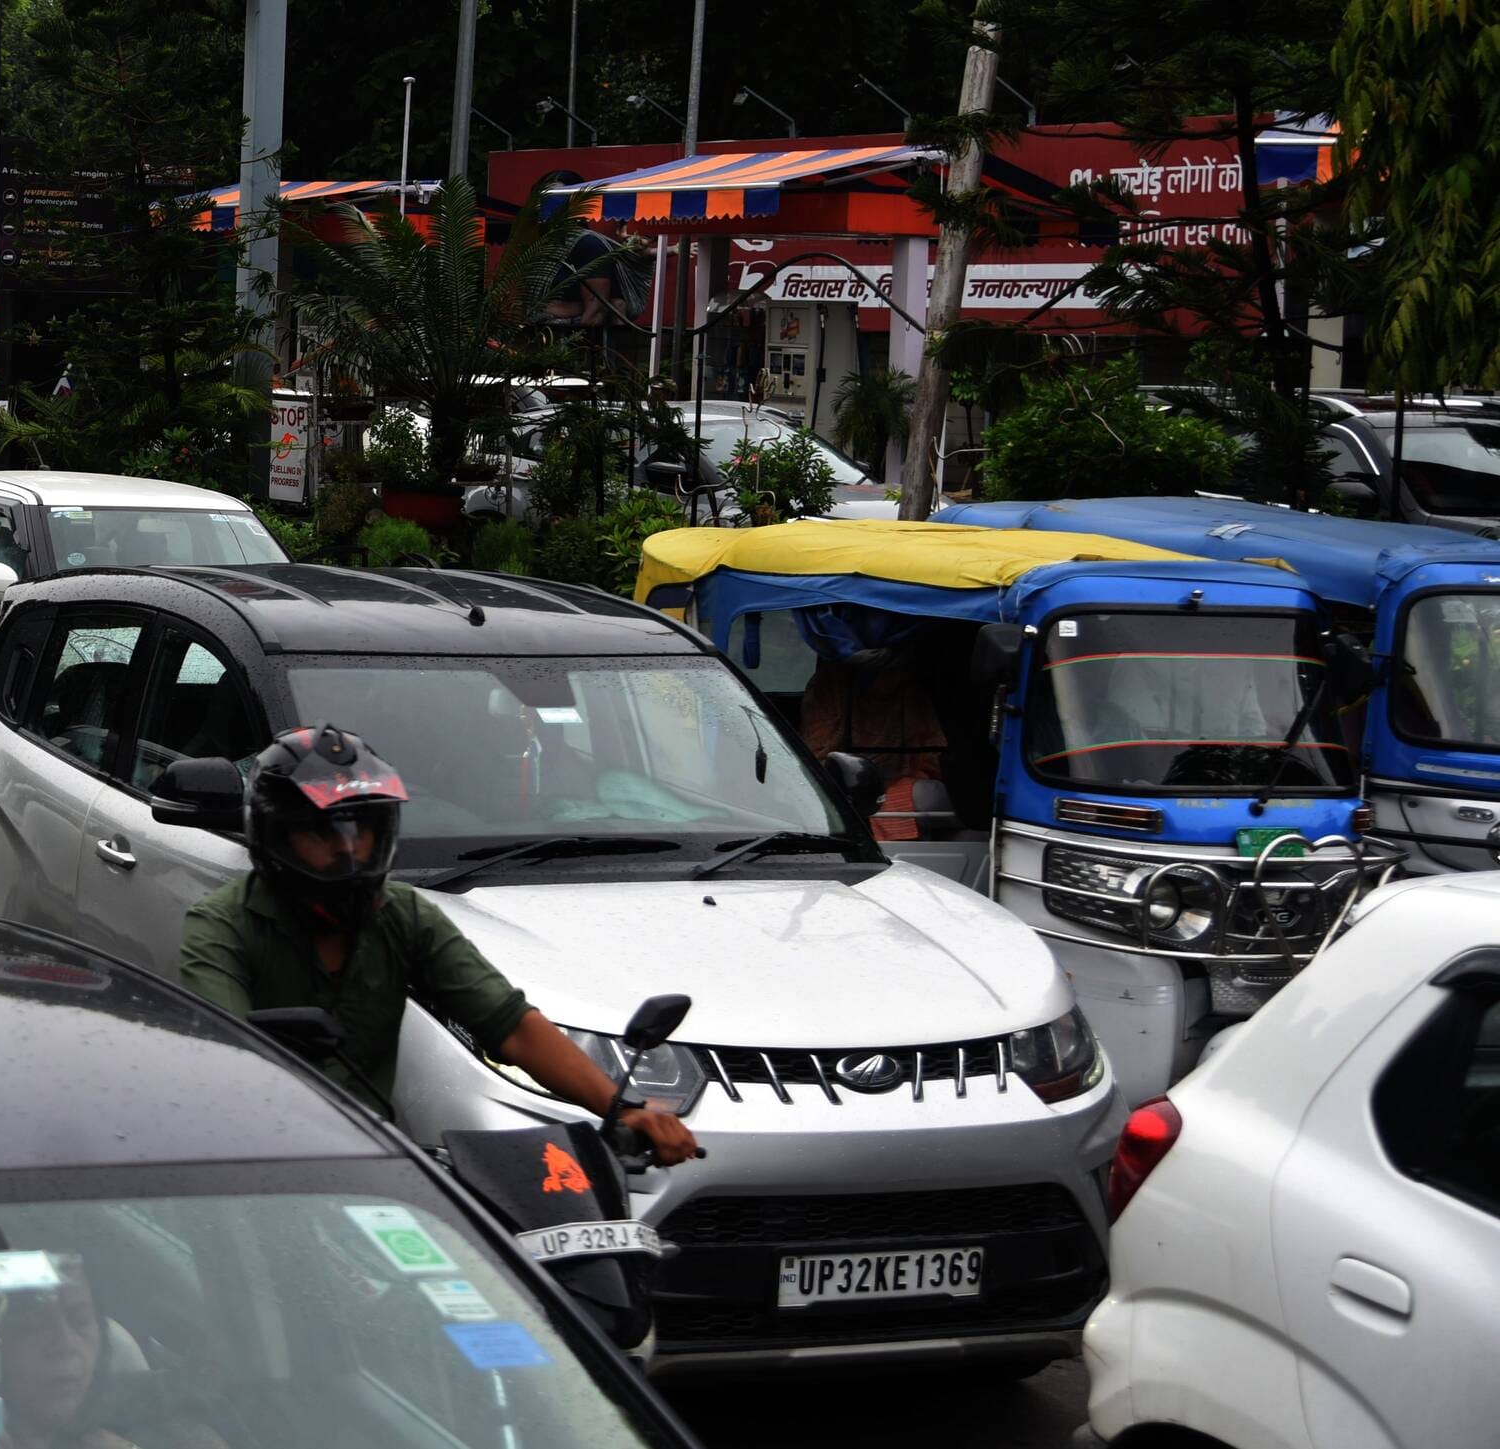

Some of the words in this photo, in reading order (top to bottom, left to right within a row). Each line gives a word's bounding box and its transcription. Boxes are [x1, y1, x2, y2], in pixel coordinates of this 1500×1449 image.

[1166, 156, 1217, 194] लोगों
[1217, 154, 1244, 193] को
[782, 273, 848, 299] विश्वास
[269, 406, 305, 427] STOP
[270, 465, 296, 475] FUELLING
[296, 467, 302, 476] IN
[271, 477, 299, 488] PROGRESS
[541, 1231, 571, 1255] UP
[580, 1226, 628, 1250] 32RJ
[780, 1273, 797, 1284] IND
[798, 1251, 980, 1296] UP32KE1369
